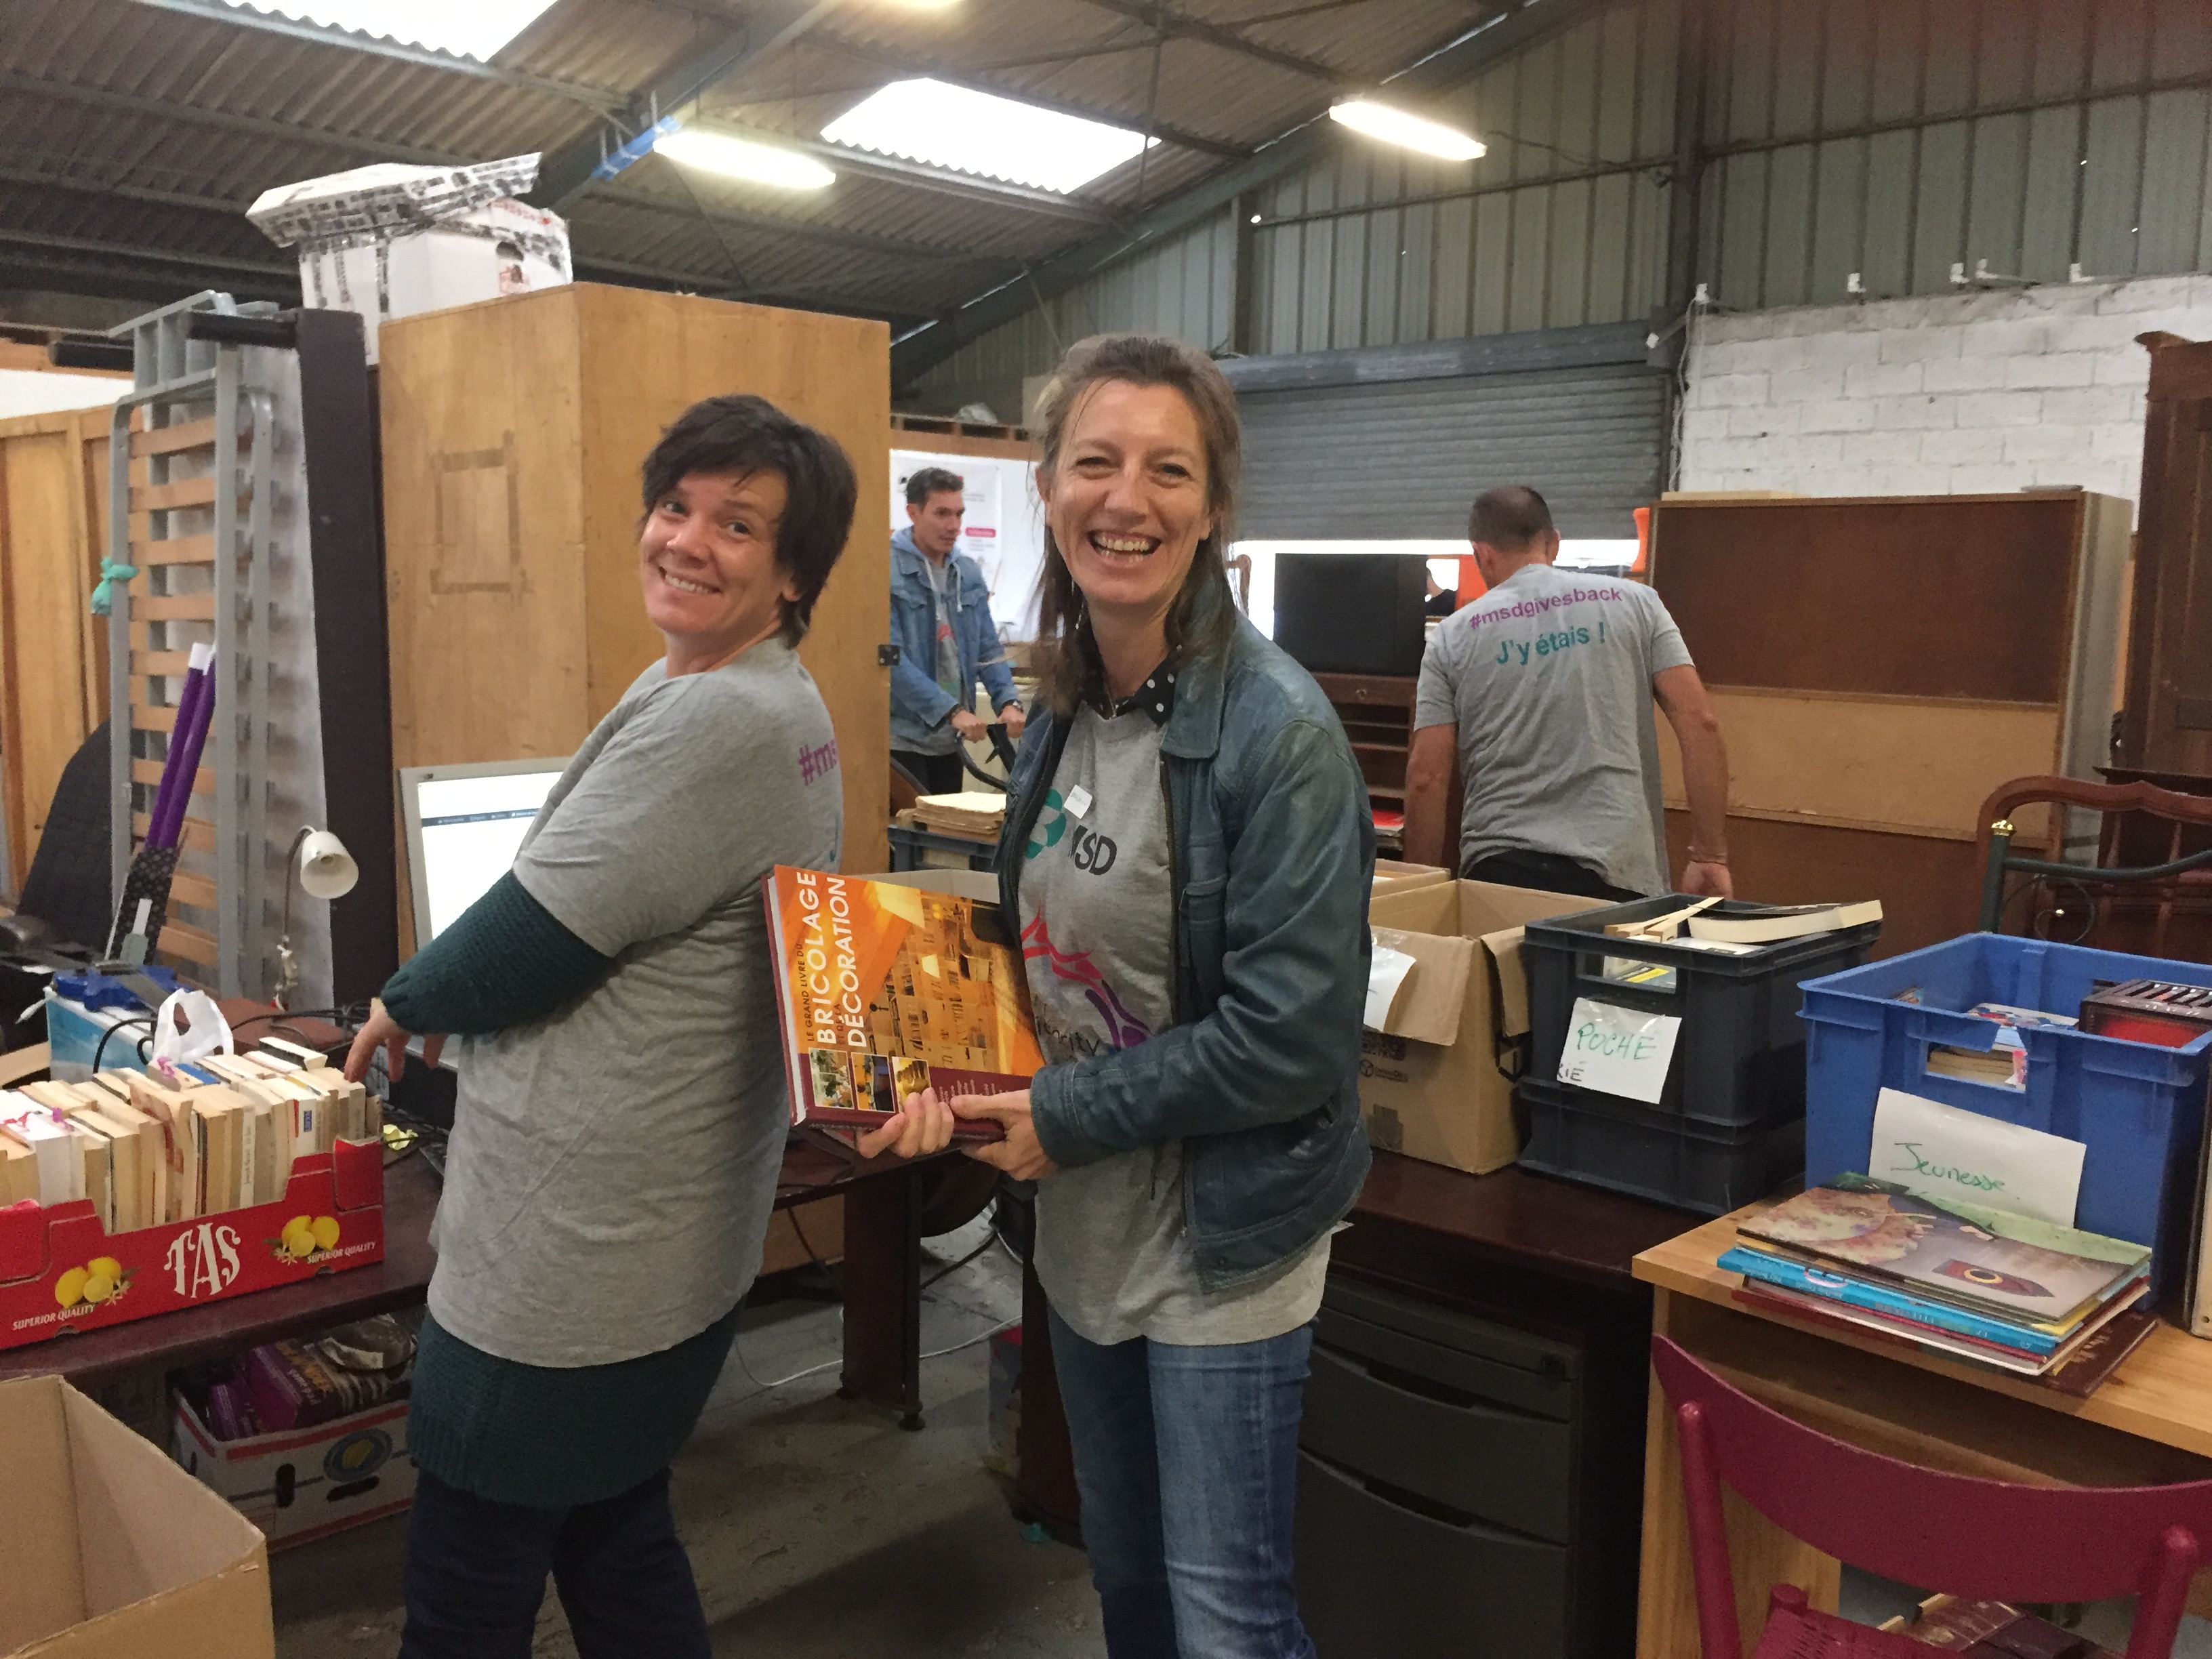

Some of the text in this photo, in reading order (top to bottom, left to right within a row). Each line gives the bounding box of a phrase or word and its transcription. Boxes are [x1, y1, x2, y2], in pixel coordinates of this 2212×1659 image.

[1469, 588, 1622, 630] #msdgivesback
[1496, 621, 1605, 665] J'y étais !
[1068, 825, 1117, 876] SD
[796, 872, 836, 1044] BRICOLAGE
[826, 877, 867, 1047] DÉCORATION
[794, 943, 815, 1042] LE GRAND LIVRE DU
[1576, 1022, 1657, 1060] POCHE
[1890, 1143, 2007, 1193] Jeunesse
[164, 1223, 241, 1298] TAS
[307, 1241, 376, 1265] SUPERIOR QUALITY
[12, 1304, 95, 1331] SUPERIOR QUALITY
